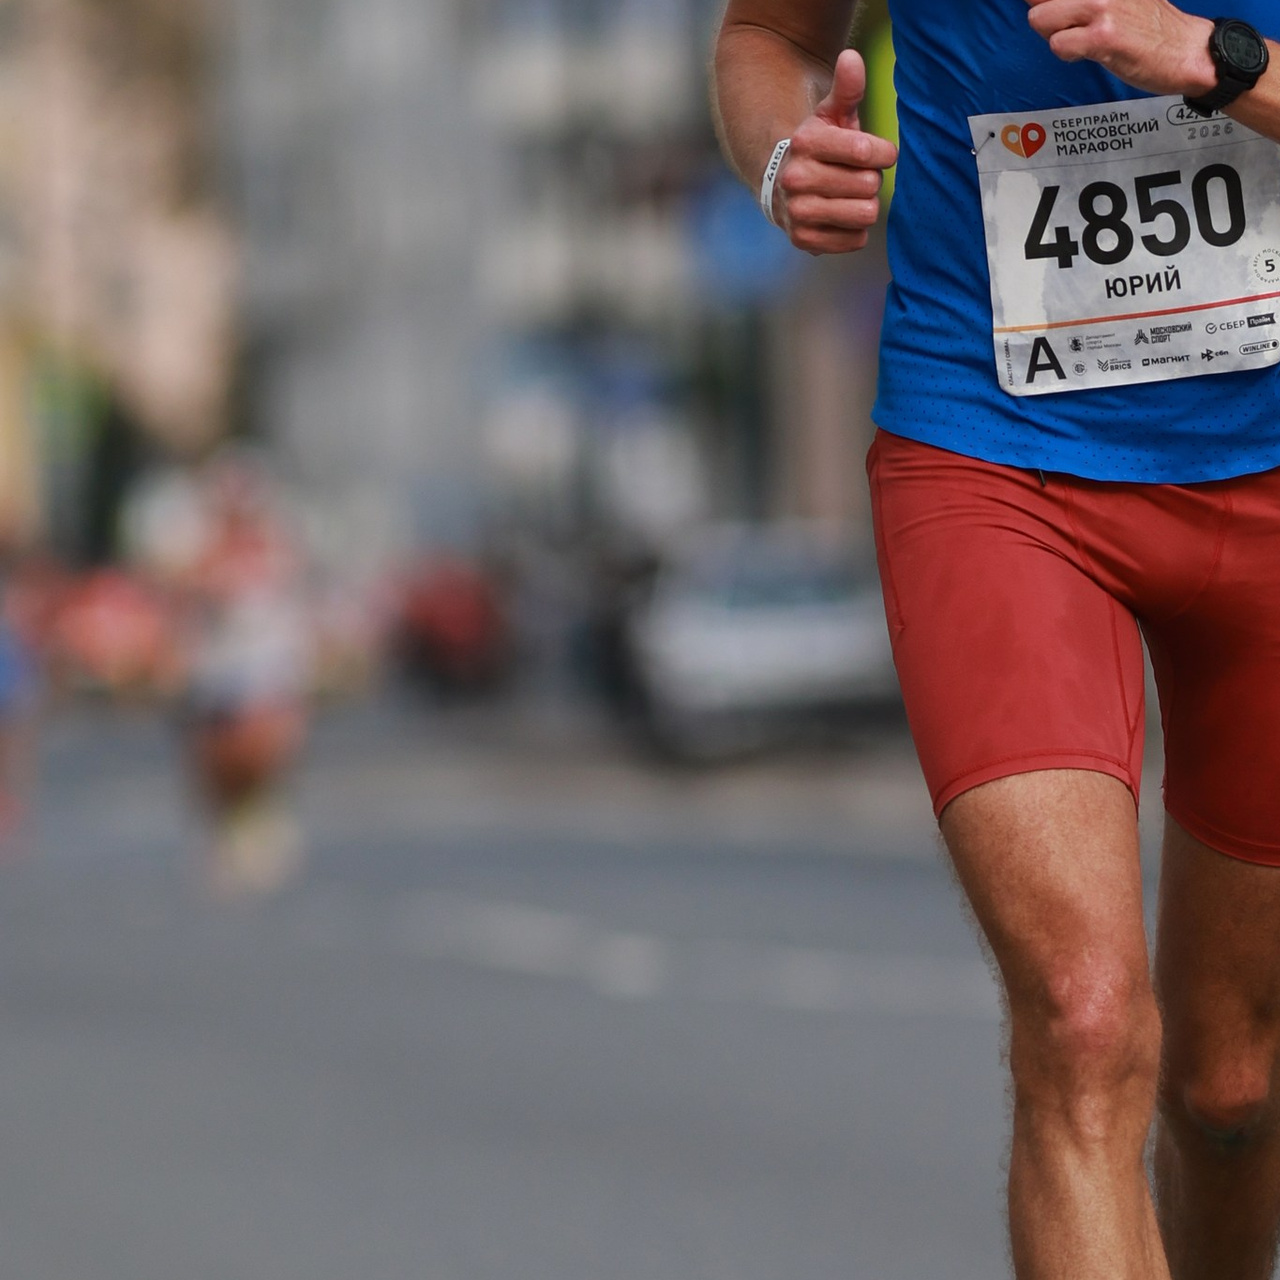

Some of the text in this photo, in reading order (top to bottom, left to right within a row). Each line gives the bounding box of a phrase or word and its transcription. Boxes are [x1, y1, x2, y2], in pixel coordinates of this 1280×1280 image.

[1052, 111, 1130, 129] СБЕРПРАЙМ
[1054, 118, 1160, 143] МОСКОВСКИЙ
[1188, 122, 1234, 140] 2026
[1056, 137, 1133, 157] МАРАФОН
[767, 142, 788, 182] 4850
[1024, 163, 1246, 269] 4850
[1264, 258, 1276, 273] 5
[1105, 265, 1181, 299] ЮРИЙ
[1149, 322, 1193, 336] МОСКОВСКИЙ
[1219, 320, 1246, 331] СБЕР
[1151, 334, 1171, 344] СПОРТ
[1242, 342, 1271, 353] WINLINE
[1025, 336, 1067, 384] A
[1110, 363, 1132, 371] BRICS
